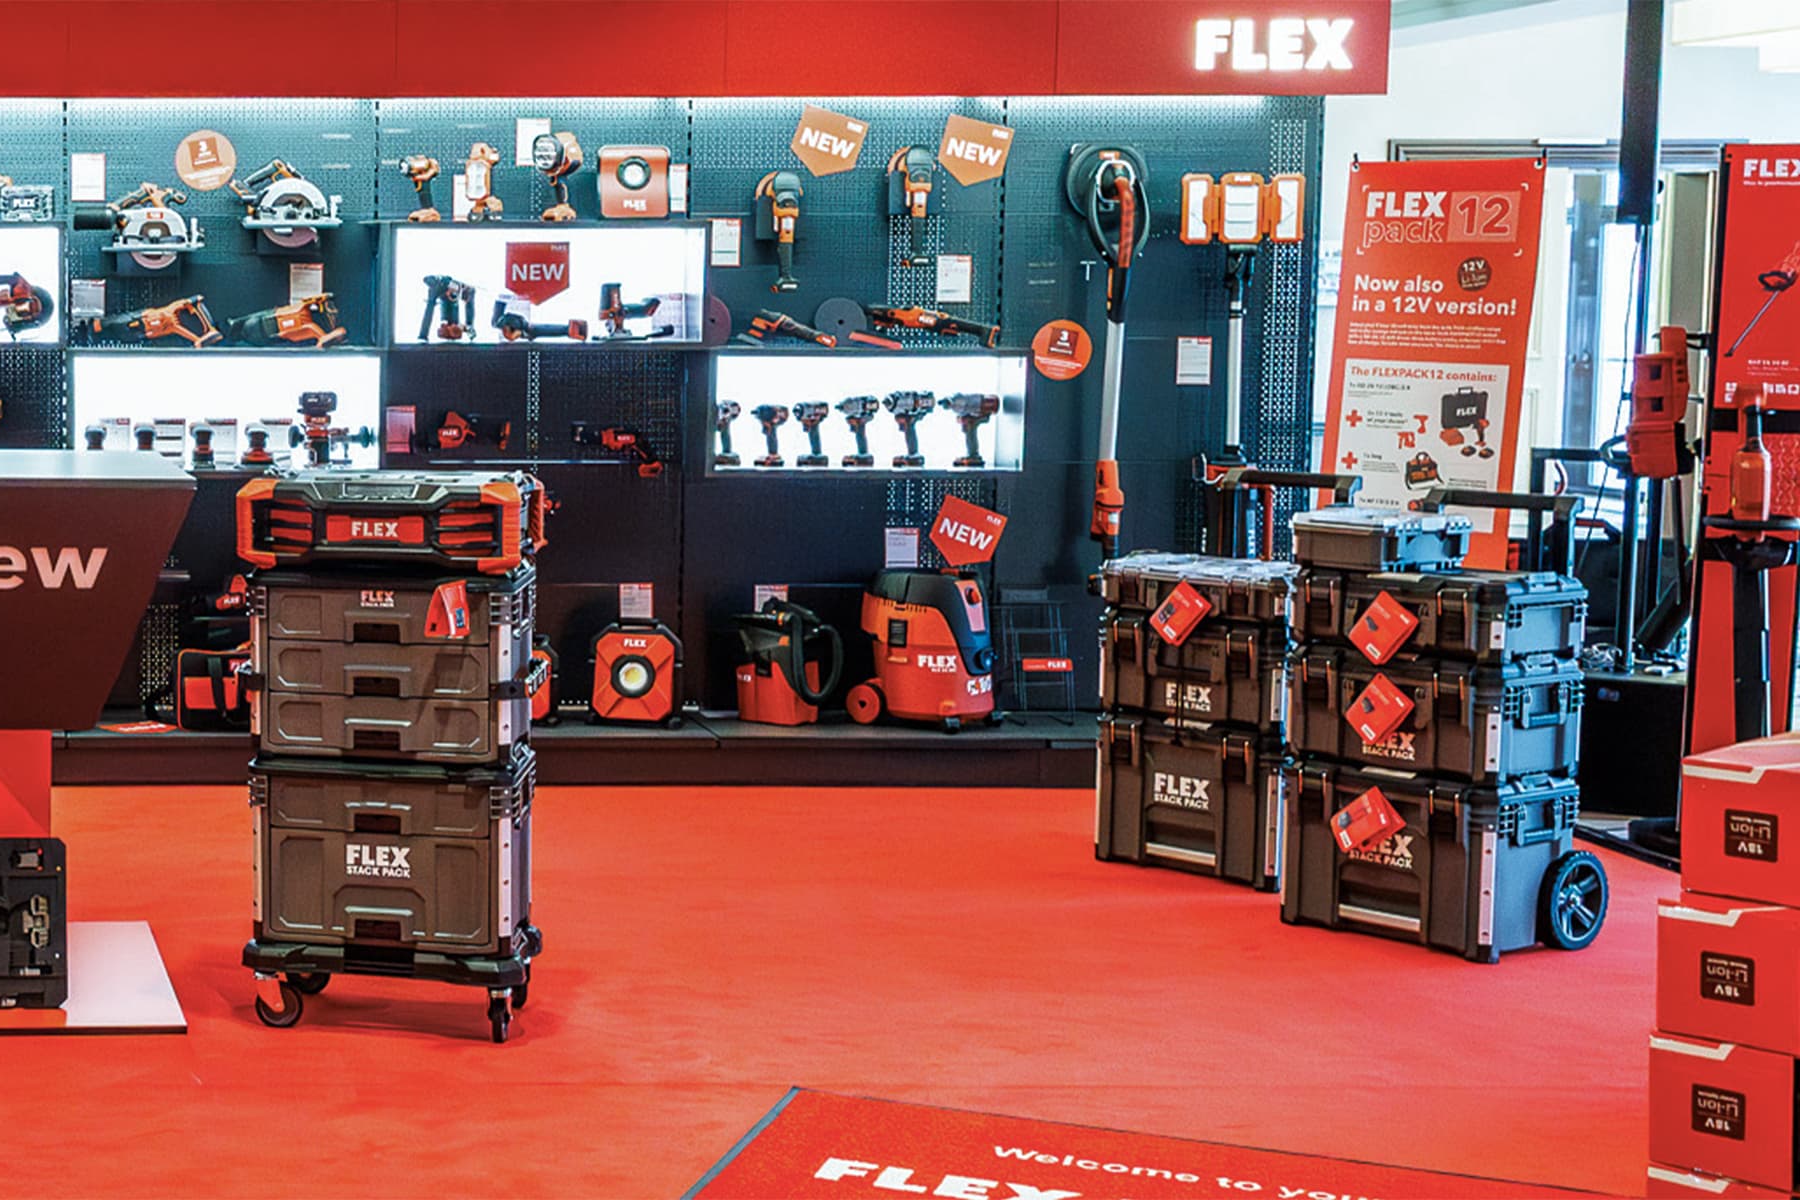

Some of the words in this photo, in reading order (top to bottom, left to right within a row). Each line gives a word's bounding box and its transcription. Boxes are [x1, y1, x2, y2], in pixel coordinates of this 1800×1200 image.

[1194, 18, 1356, 71] FLEX
[800, 127, 856, 158] NEW
[946, 138, 1002, 167] NEW
[13, 198, 36, 208] FLEX
[1365, 191, 1447, 218] FLEX
[1456, 194, 1512, 236] 12
[1363, 217, 1445, 248] pack
[511, 263, 565, 281] NEW
[1463, 260, 1485, 272] 12V
[1354, 274, 1399, 292] Now
[1403, 274, 1444, 293] also
[1352, 295, 1369, 312] in
[1374, 299, 1386, 313] a
[1392, 296, 1432, 313] 12V
[1435, 297, 1517, 316] version!
[1351, 366, 1369, 377] The
[1371, 367, 1444, 381] FLEXPACK12
[1446, 370, 1497, 382] contains:
[1455, 405, 1478, 417] FLEX
[351, 521, 399, 537] FLEX
[938, 518, 993, 550] NEW
[361, 591, 394, 602] FLEX
[623, 638, 647, 648] FLEX
[917, 655, 957, 668] FLEX
[1154, 772, 1210, 800] FLEX
[1154, 793, 1183, 807] STACK
[1184, 796, 1209, 810] PACK
[346, 844, 411, 869] FLEX
[1738, 841, 1763, 855] 18V
[1384, 855, 1413, 870] PACK
[346, 866, 380, 876] STACK
[382, 867, 411, 879] PACK
[1714, 983, 1740, 998] 18V
[1705, 1117, 1731, 1132] 18V
[994, 1146, 1199, 1183] Welcome
[1216, 1176, 1262, 1191] to
